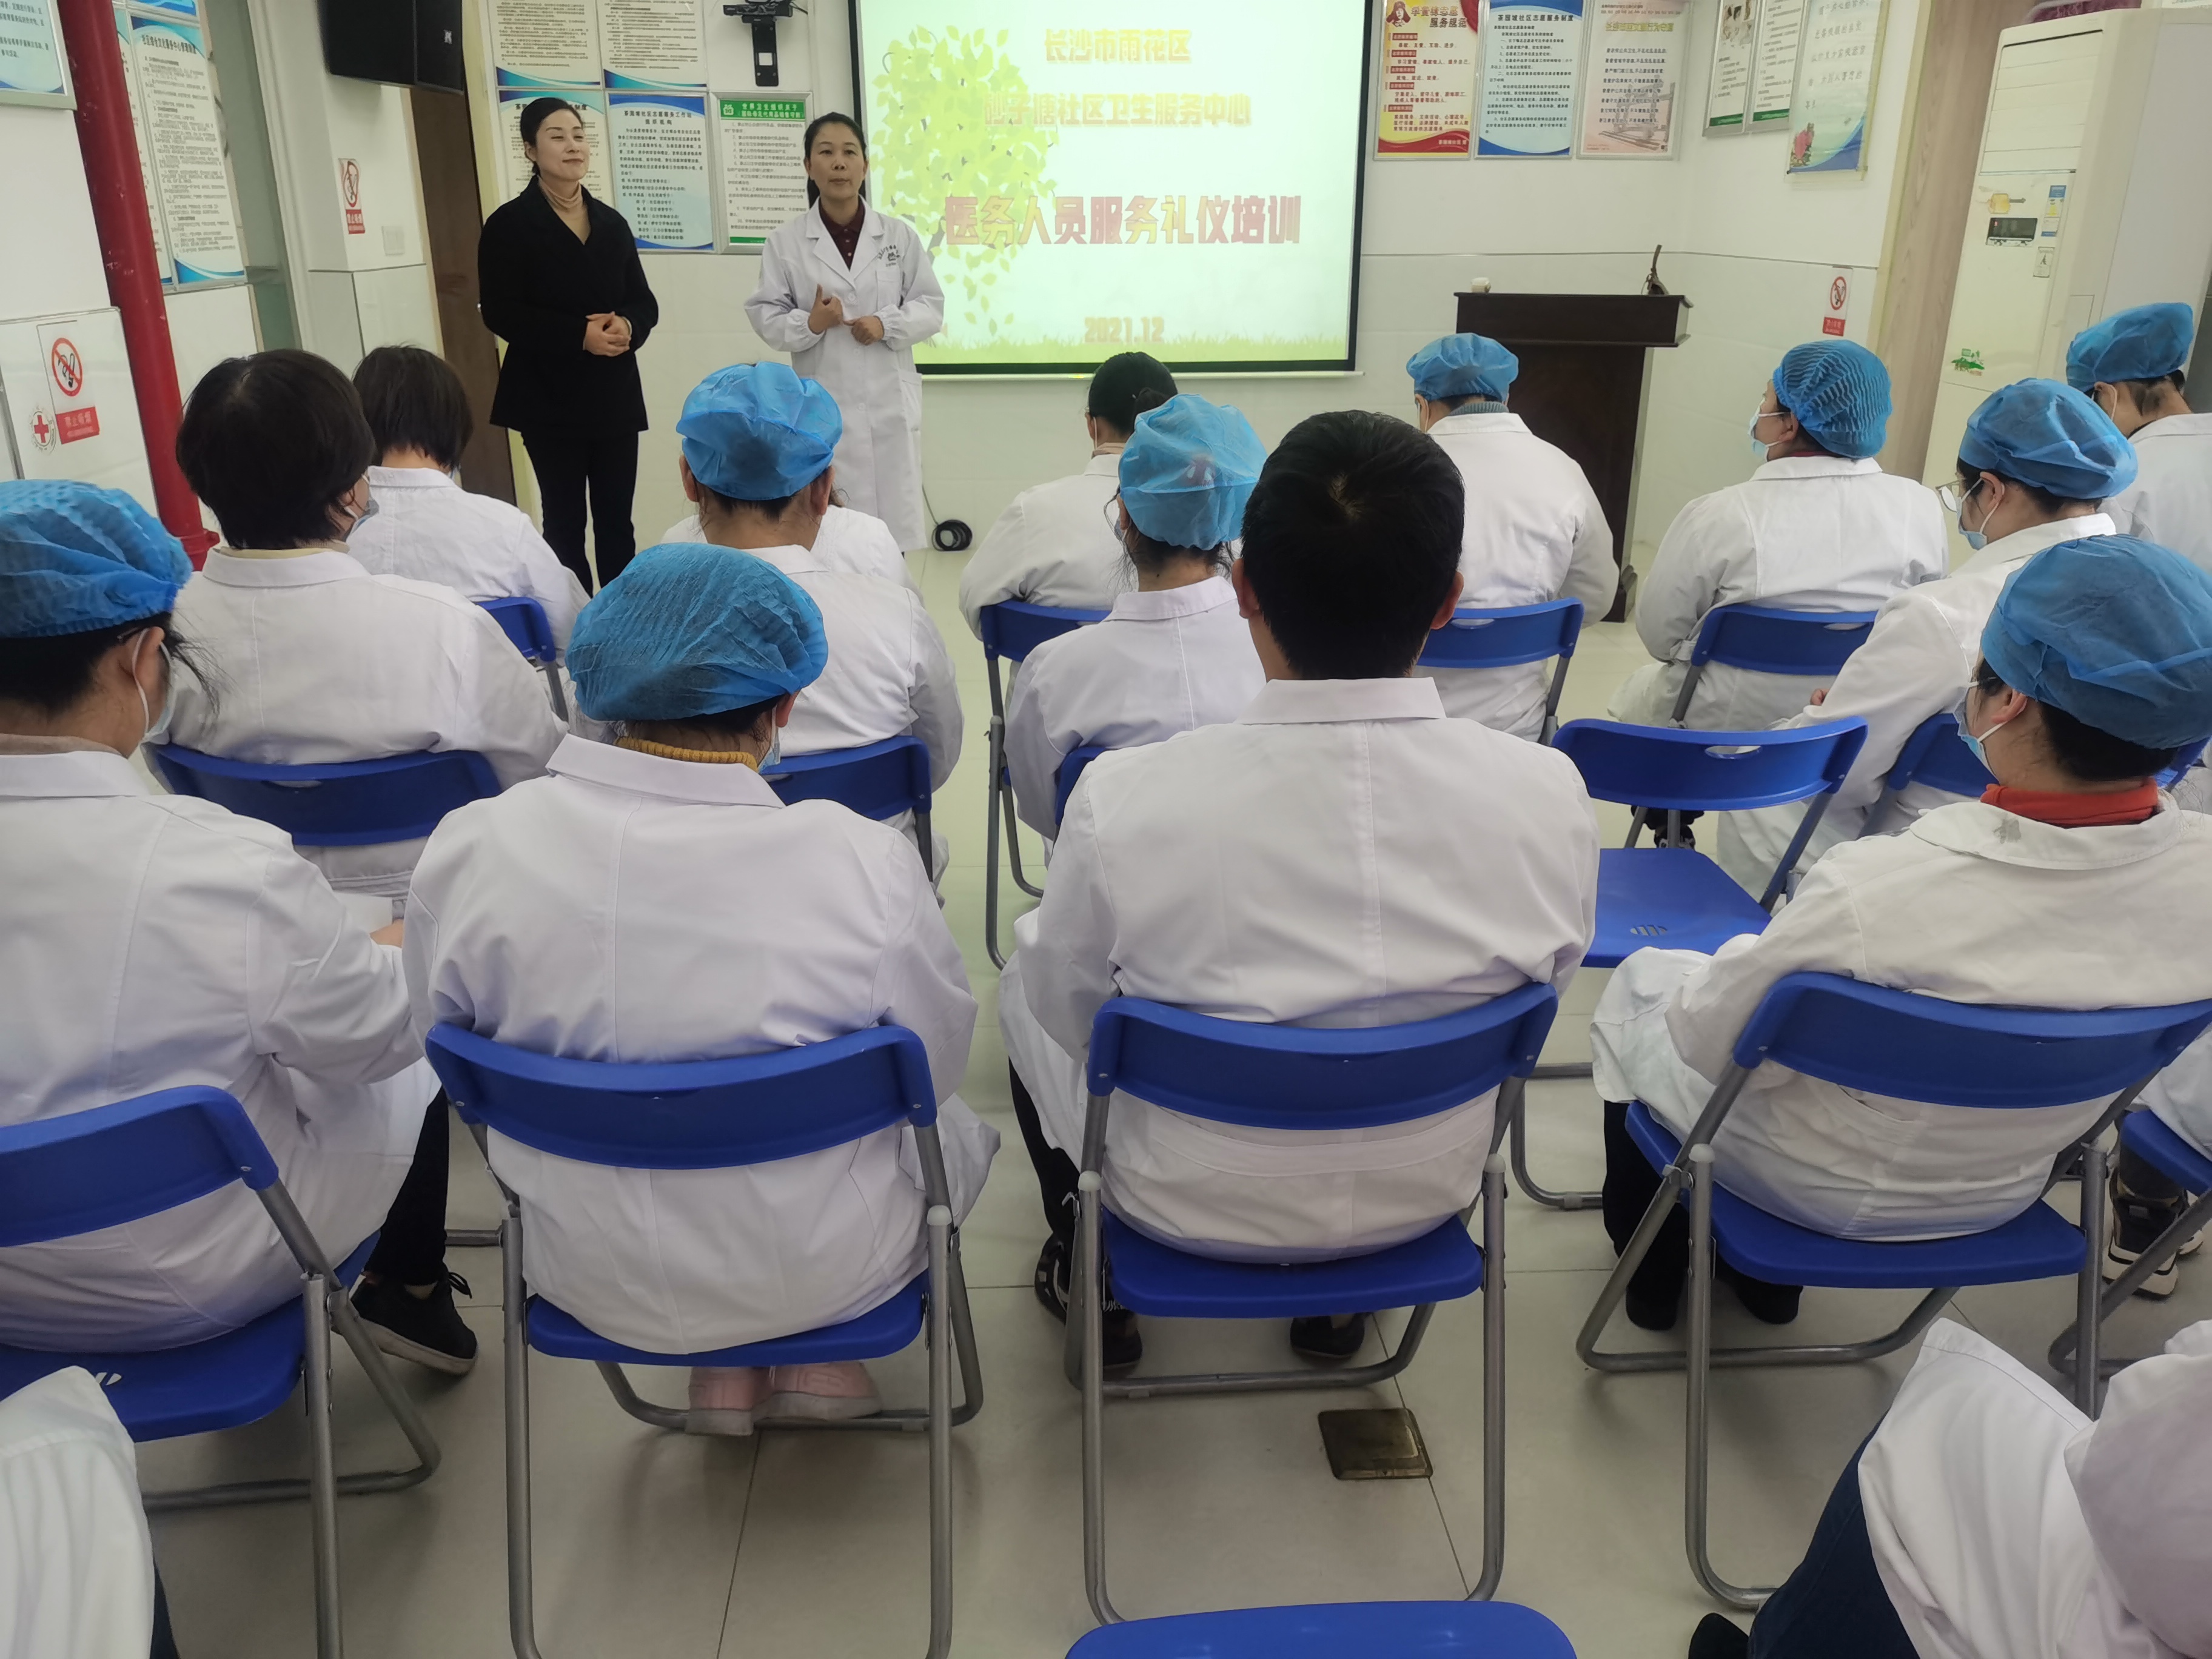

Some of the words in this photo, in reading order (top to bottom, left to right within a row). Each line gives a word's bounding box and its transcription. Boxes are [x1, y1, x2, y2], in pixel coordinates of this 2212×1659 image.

[1044, 28, 1191, 63] 长沙市雨花区
[983, 92, 1253, 126] 砂子塘社区卫生服务中心
[945, 195, 1302, 244] 医务人员服务礼仪培训
[1084, 316, 1164, 344] 2021.12
